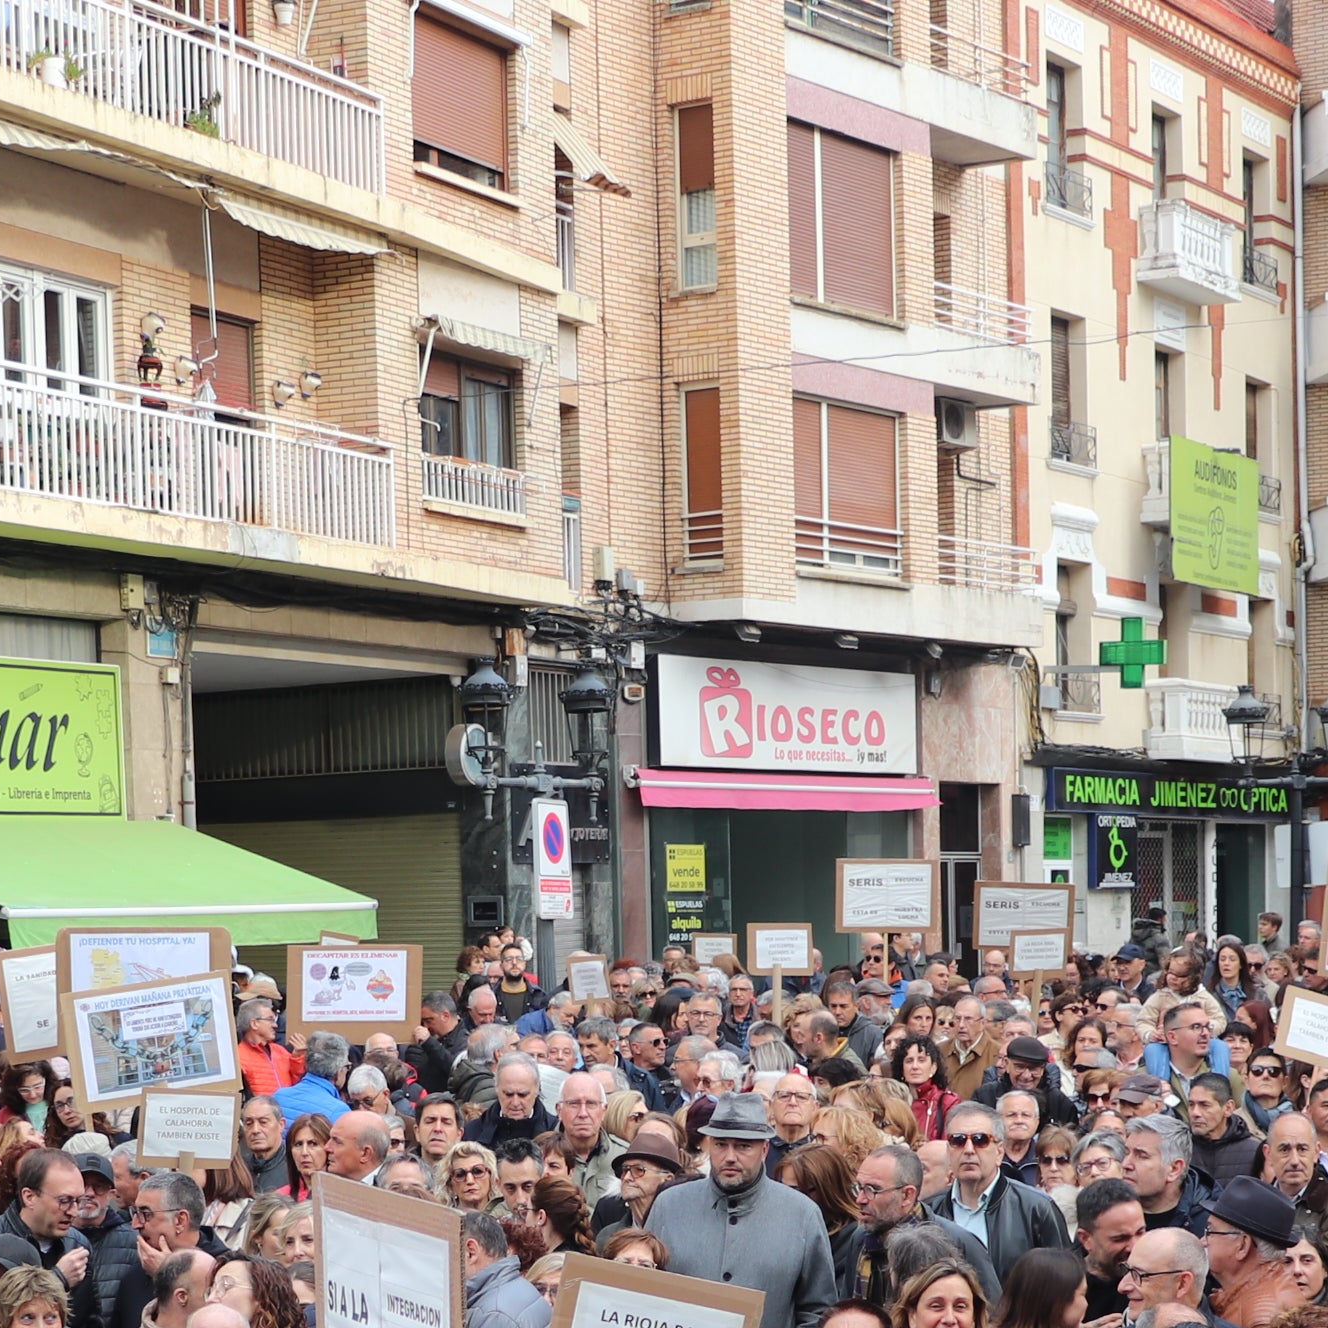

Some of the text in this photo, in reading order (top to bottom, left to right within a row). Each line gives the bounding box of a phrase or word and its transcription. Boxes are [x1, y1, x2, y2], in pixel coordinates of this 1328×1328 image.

[703, 694, 886, 755] RIOSECO
[774, 747, 785, 760] Lo
[787, 749, 803, 763] que
[45, 791, 51, 800] e
[51, 788, 92, 802] Imprenta
[1066, 775, 1140, 806] FARMACIA
[1150, 777, 1217, 808] JIMÉNEZ
[672, 866, 700, 877] vende
[848, 878, 884, 887] SERIS
[985, 900, 1020, 910] SERIS
[672, 917, 702, 931] alquila
[79, 937, 124, 947] ¡DEFIENDE
[125, 937, 138, 945] TU
[139, 936, 180, 945] HOSPITAL
[94, 1001, 109, 1010] HOY
[110, 997, 140, 1009] DERIVAN
[36, 1020, 50, 1028] SE
[159, 1106, 220, 1116] EL HOSPITAL DE
[165, 1119, 213, 1128] CALAHORRA
[157, 1131, 221, 1141] TAMBIEN EXISTE
[327, 1279, 369, 1326] SI A LA
[386, 1291, 442, 1328] INTEGRACION
[600, 1308, 619, 1326] LA
